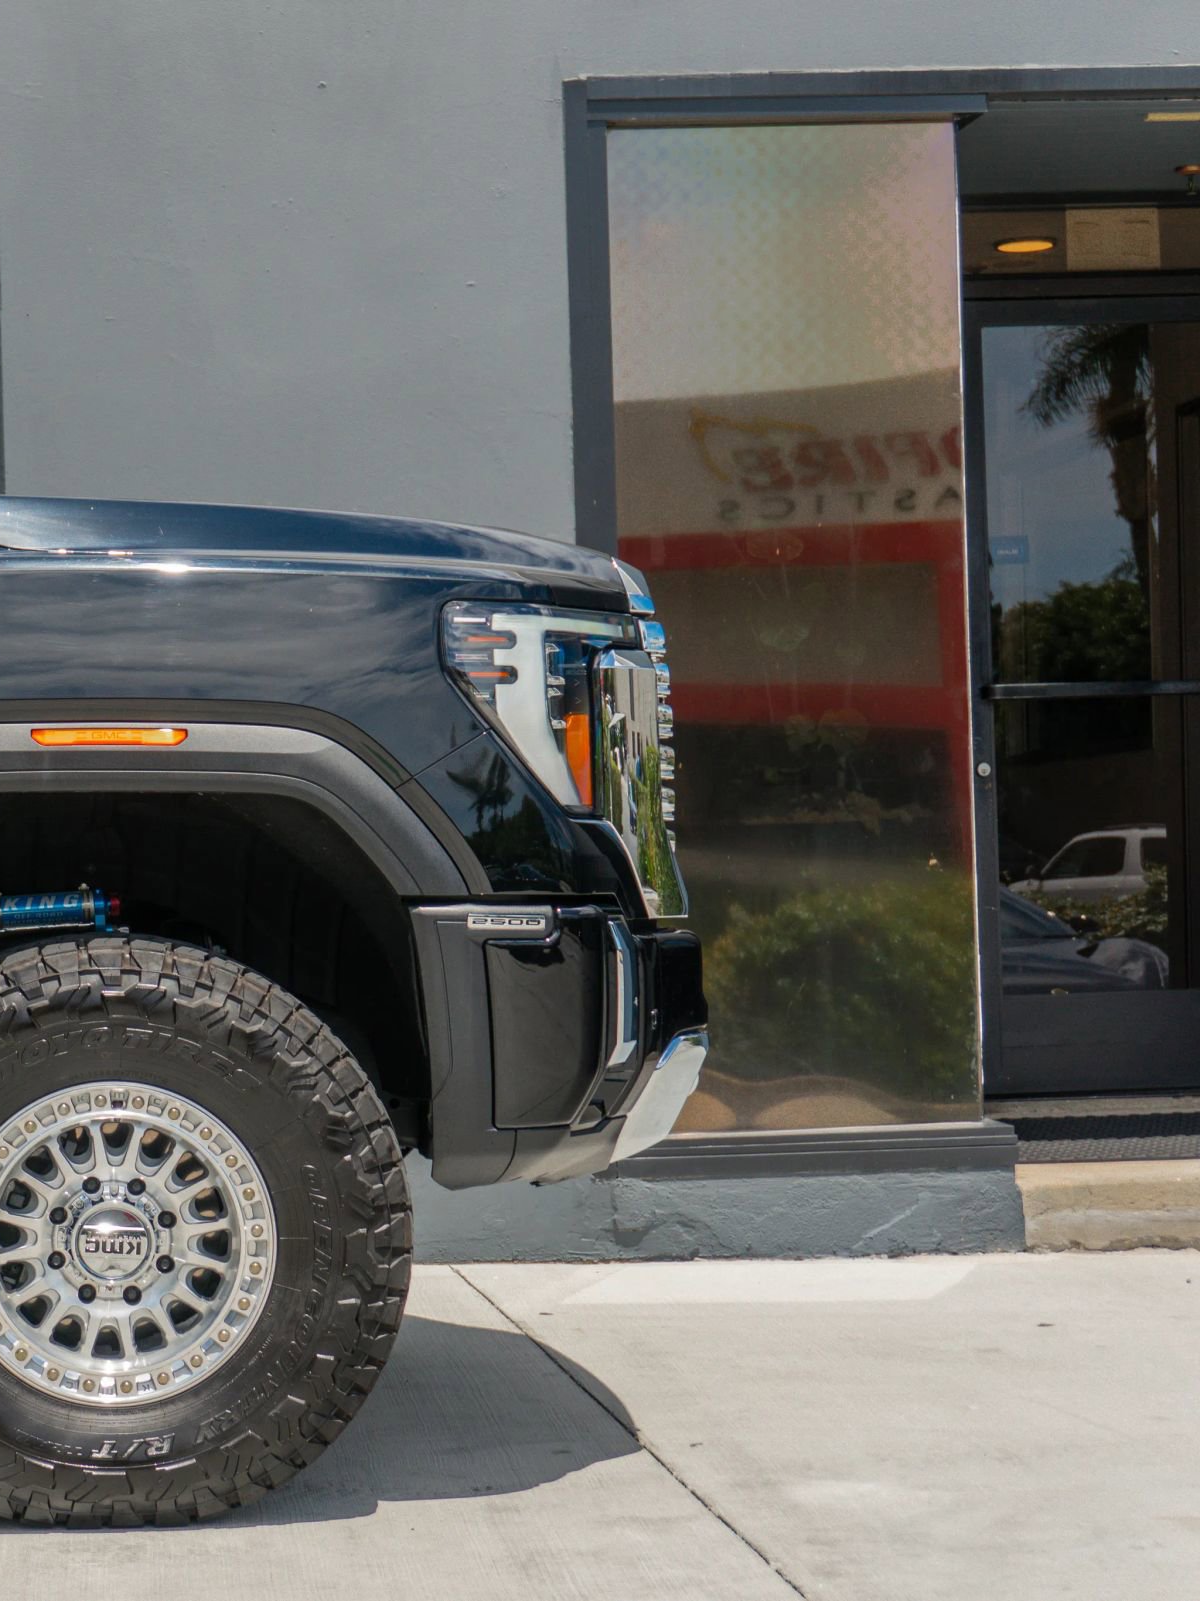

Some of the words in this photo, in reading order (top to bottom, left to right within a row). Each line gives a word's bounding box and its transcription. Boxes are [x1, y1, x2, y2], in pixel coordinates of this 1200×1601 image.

[3, 894, 80, 911] KING
[472, 918, 541, 926] 2500
[91, 1432, 176, 1459] R/T
